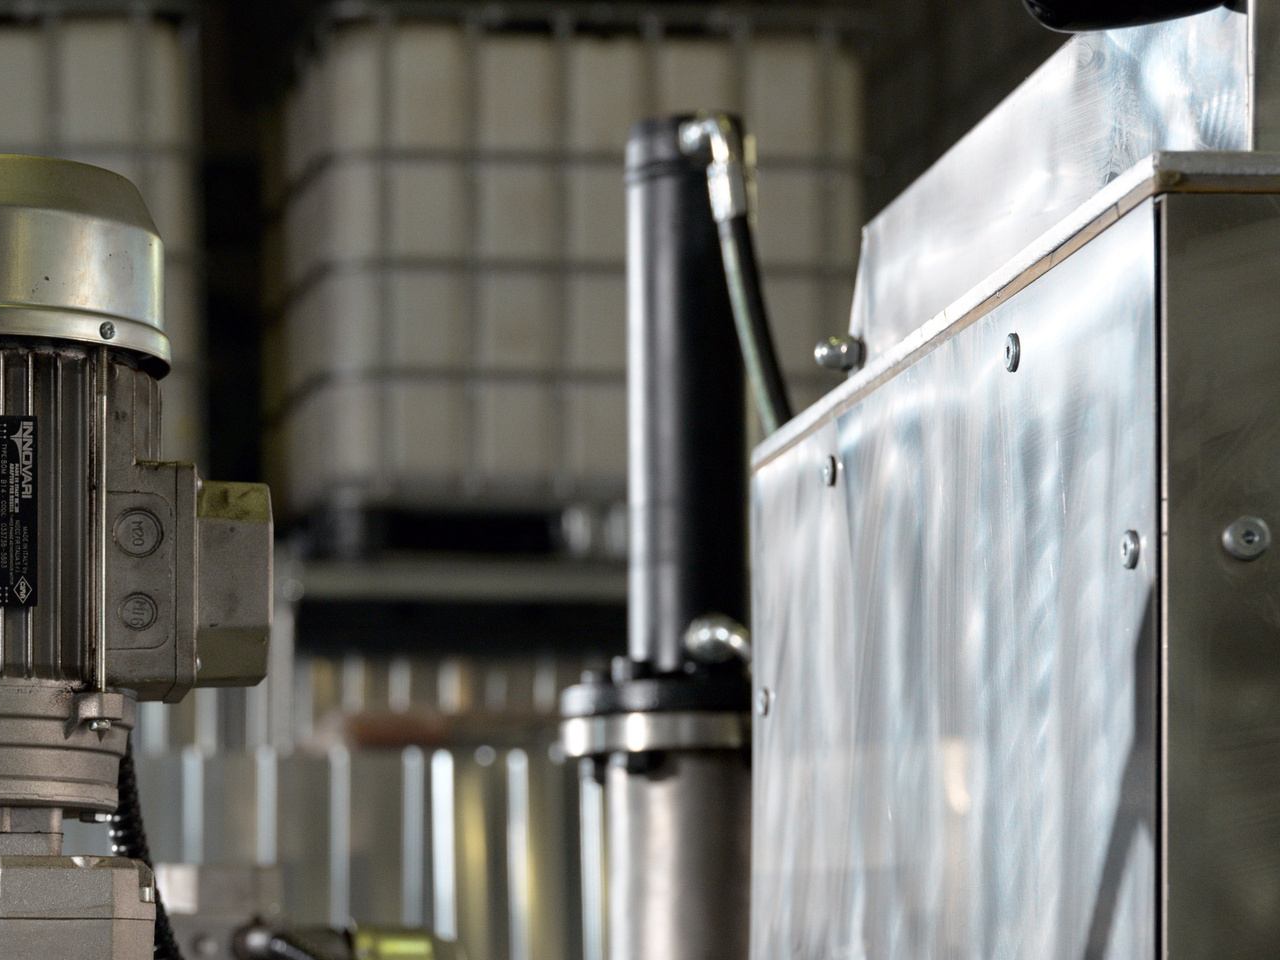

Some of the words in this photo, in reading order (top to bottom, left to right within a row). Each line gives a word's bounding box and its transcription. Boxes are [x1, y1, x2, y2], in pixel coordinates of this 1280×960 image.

[22, 421, 33, 498] INNOVARI
[131, 520, 145, 547] M20
[131, 600, 146, 626] M16
